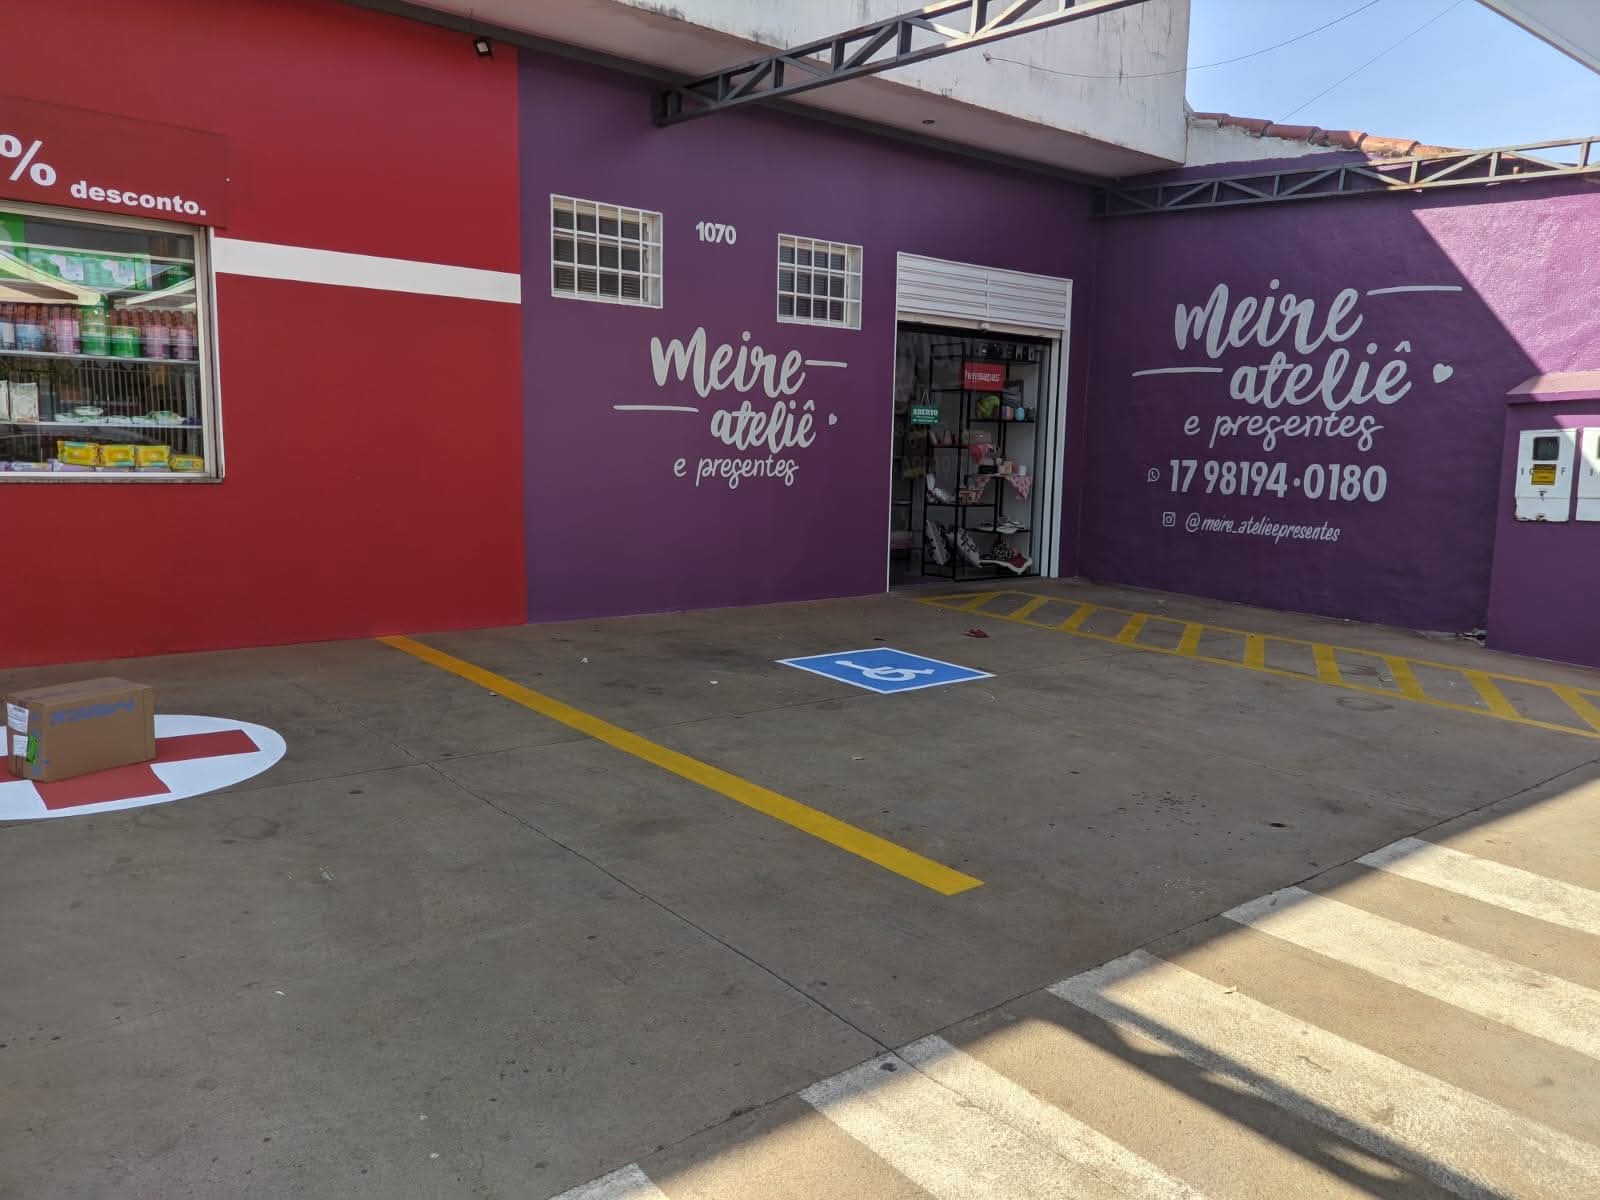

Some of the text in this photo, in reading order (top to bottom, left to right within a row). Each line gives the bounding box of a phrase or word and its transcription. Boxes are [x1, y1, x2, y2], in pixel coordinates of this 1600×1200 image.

[70, 180, 207, 216] desconto.
[695, 221, 737, 245] 1070
[1174, 278, 1364, 359] Meire
[650, 326, 806, 398] Meire
[1229, 341, 1413, 412] ateliê
[710, 399, 817, 454] ateliê
[1184, 411, 1385, 452] e presentes
[673, 454, 800, 490] e presentes
[1169, 459, 1199, 493] 17
